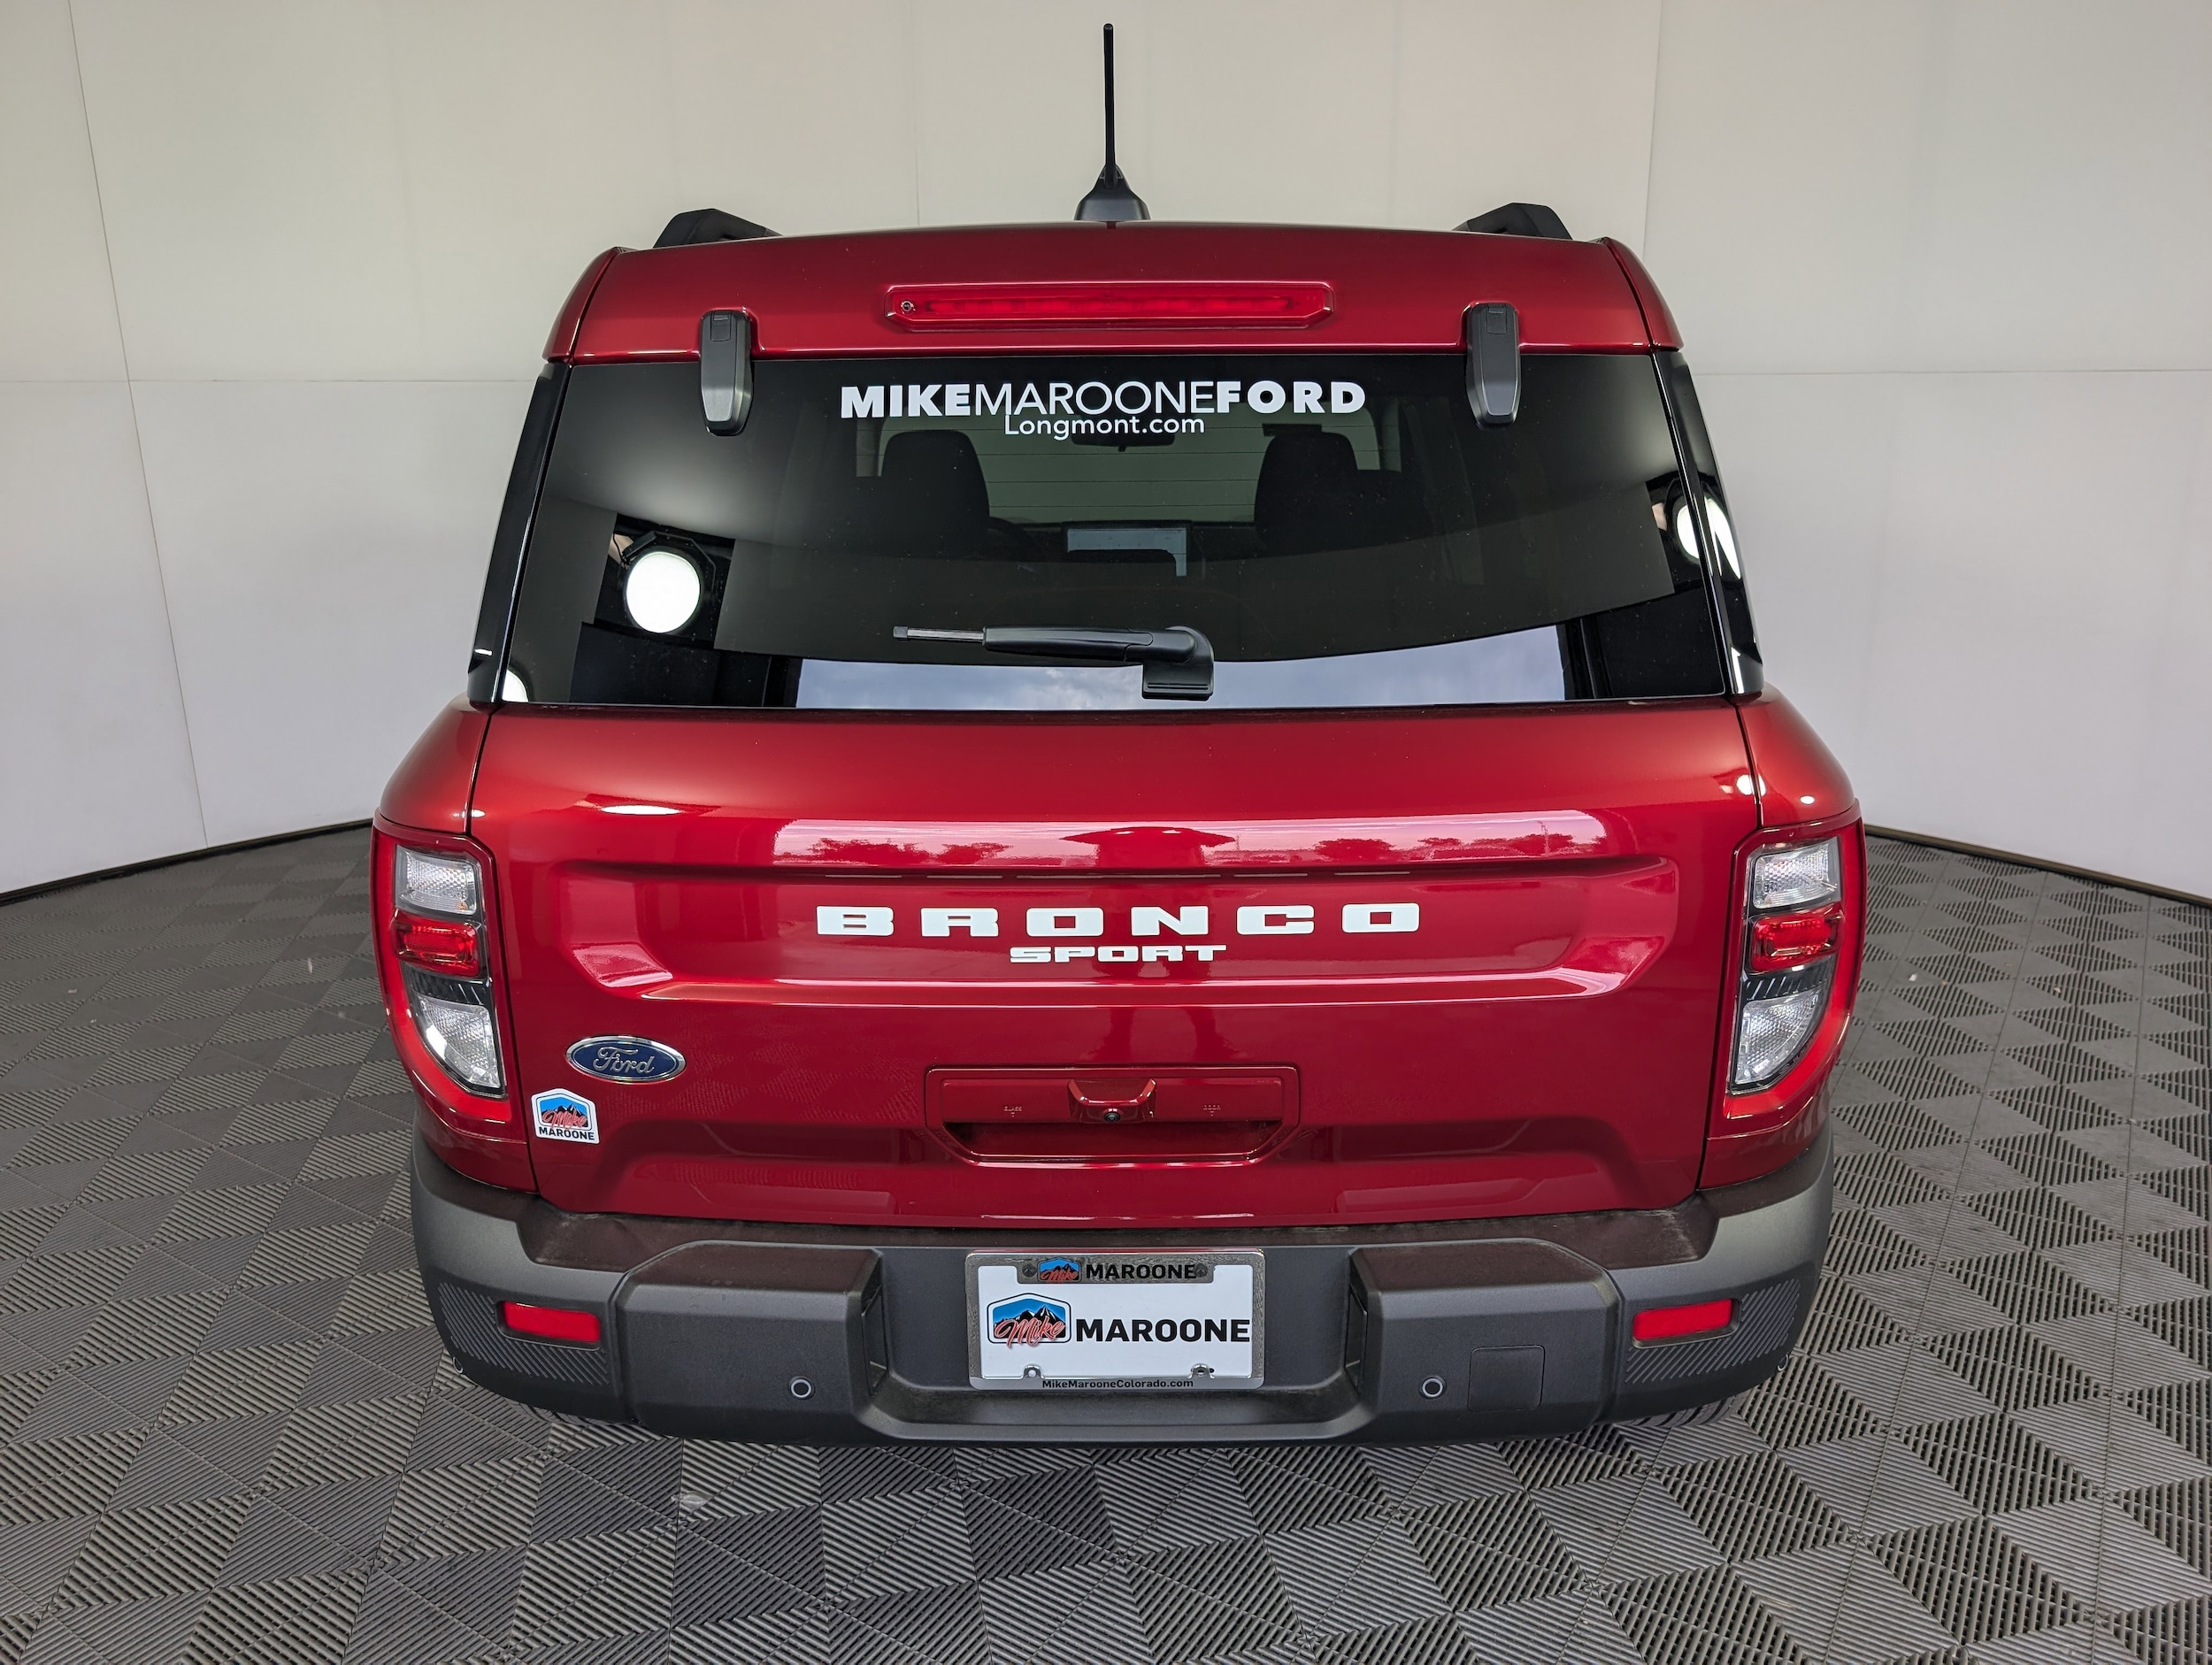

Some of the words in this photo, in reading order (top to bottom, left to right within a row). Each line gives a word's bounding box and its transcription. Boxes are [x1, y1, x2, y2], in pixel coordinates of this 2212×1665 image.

[1004, 416, 1205, 441] Longmont.com
[817, 902, 1420, 938] BRONCO
[1010, 945, 1227, 963] SPORT
[593, 1047, 655, 1074] Ford
[541, 1109, 588, 1130] Mike
[538, 1126, 595, 1141] MAROONE
[1038, 1269, 1079, 1283] Mike
[1086, 1264, 1196, 1279] MAROONE
[995, 1316, 1065, 1348] Mike
[1075, 1318, 1251, 1342] MAROONE
[1041, 1379, 1194, 1388] MikeMarooneColorado.com
